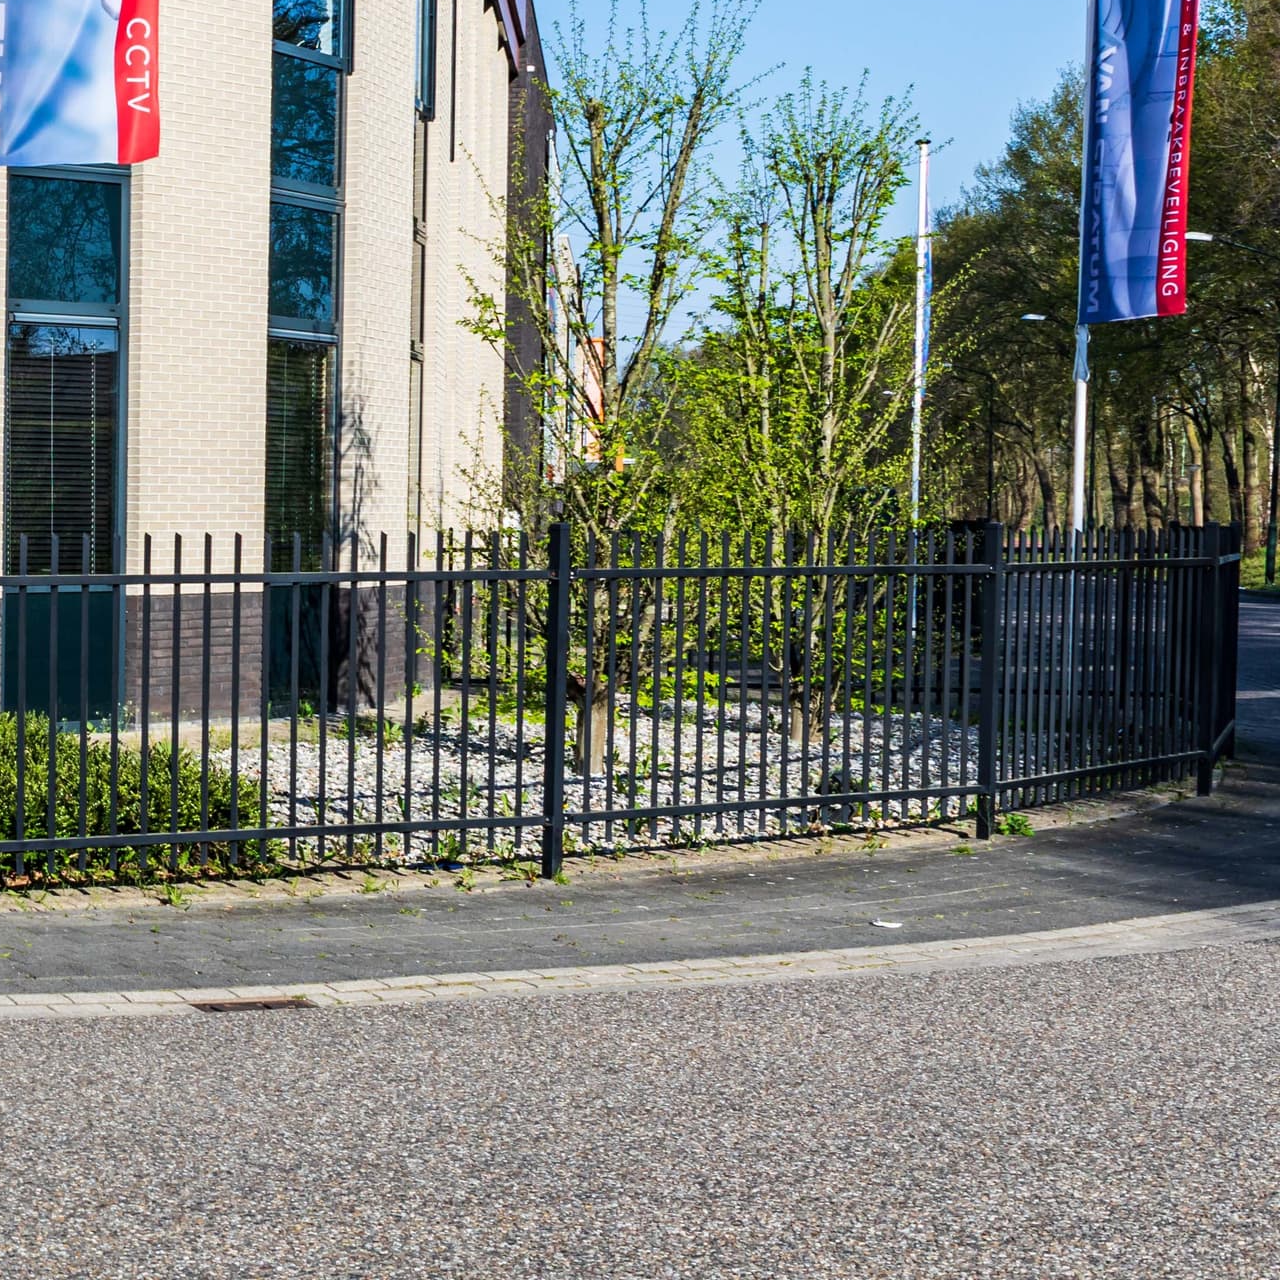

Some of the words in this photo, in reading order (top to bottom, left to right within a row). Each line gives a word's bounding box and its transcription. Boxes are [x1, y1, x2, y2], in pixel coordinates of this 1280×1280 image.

[125, 16, 152, 114] CCTV
[1182, 23, 1192, 36] &
[1096, 46, 1117, 123] VAN
[1161, 47, 1190, 297] INBRAAKBEVEILIGING
